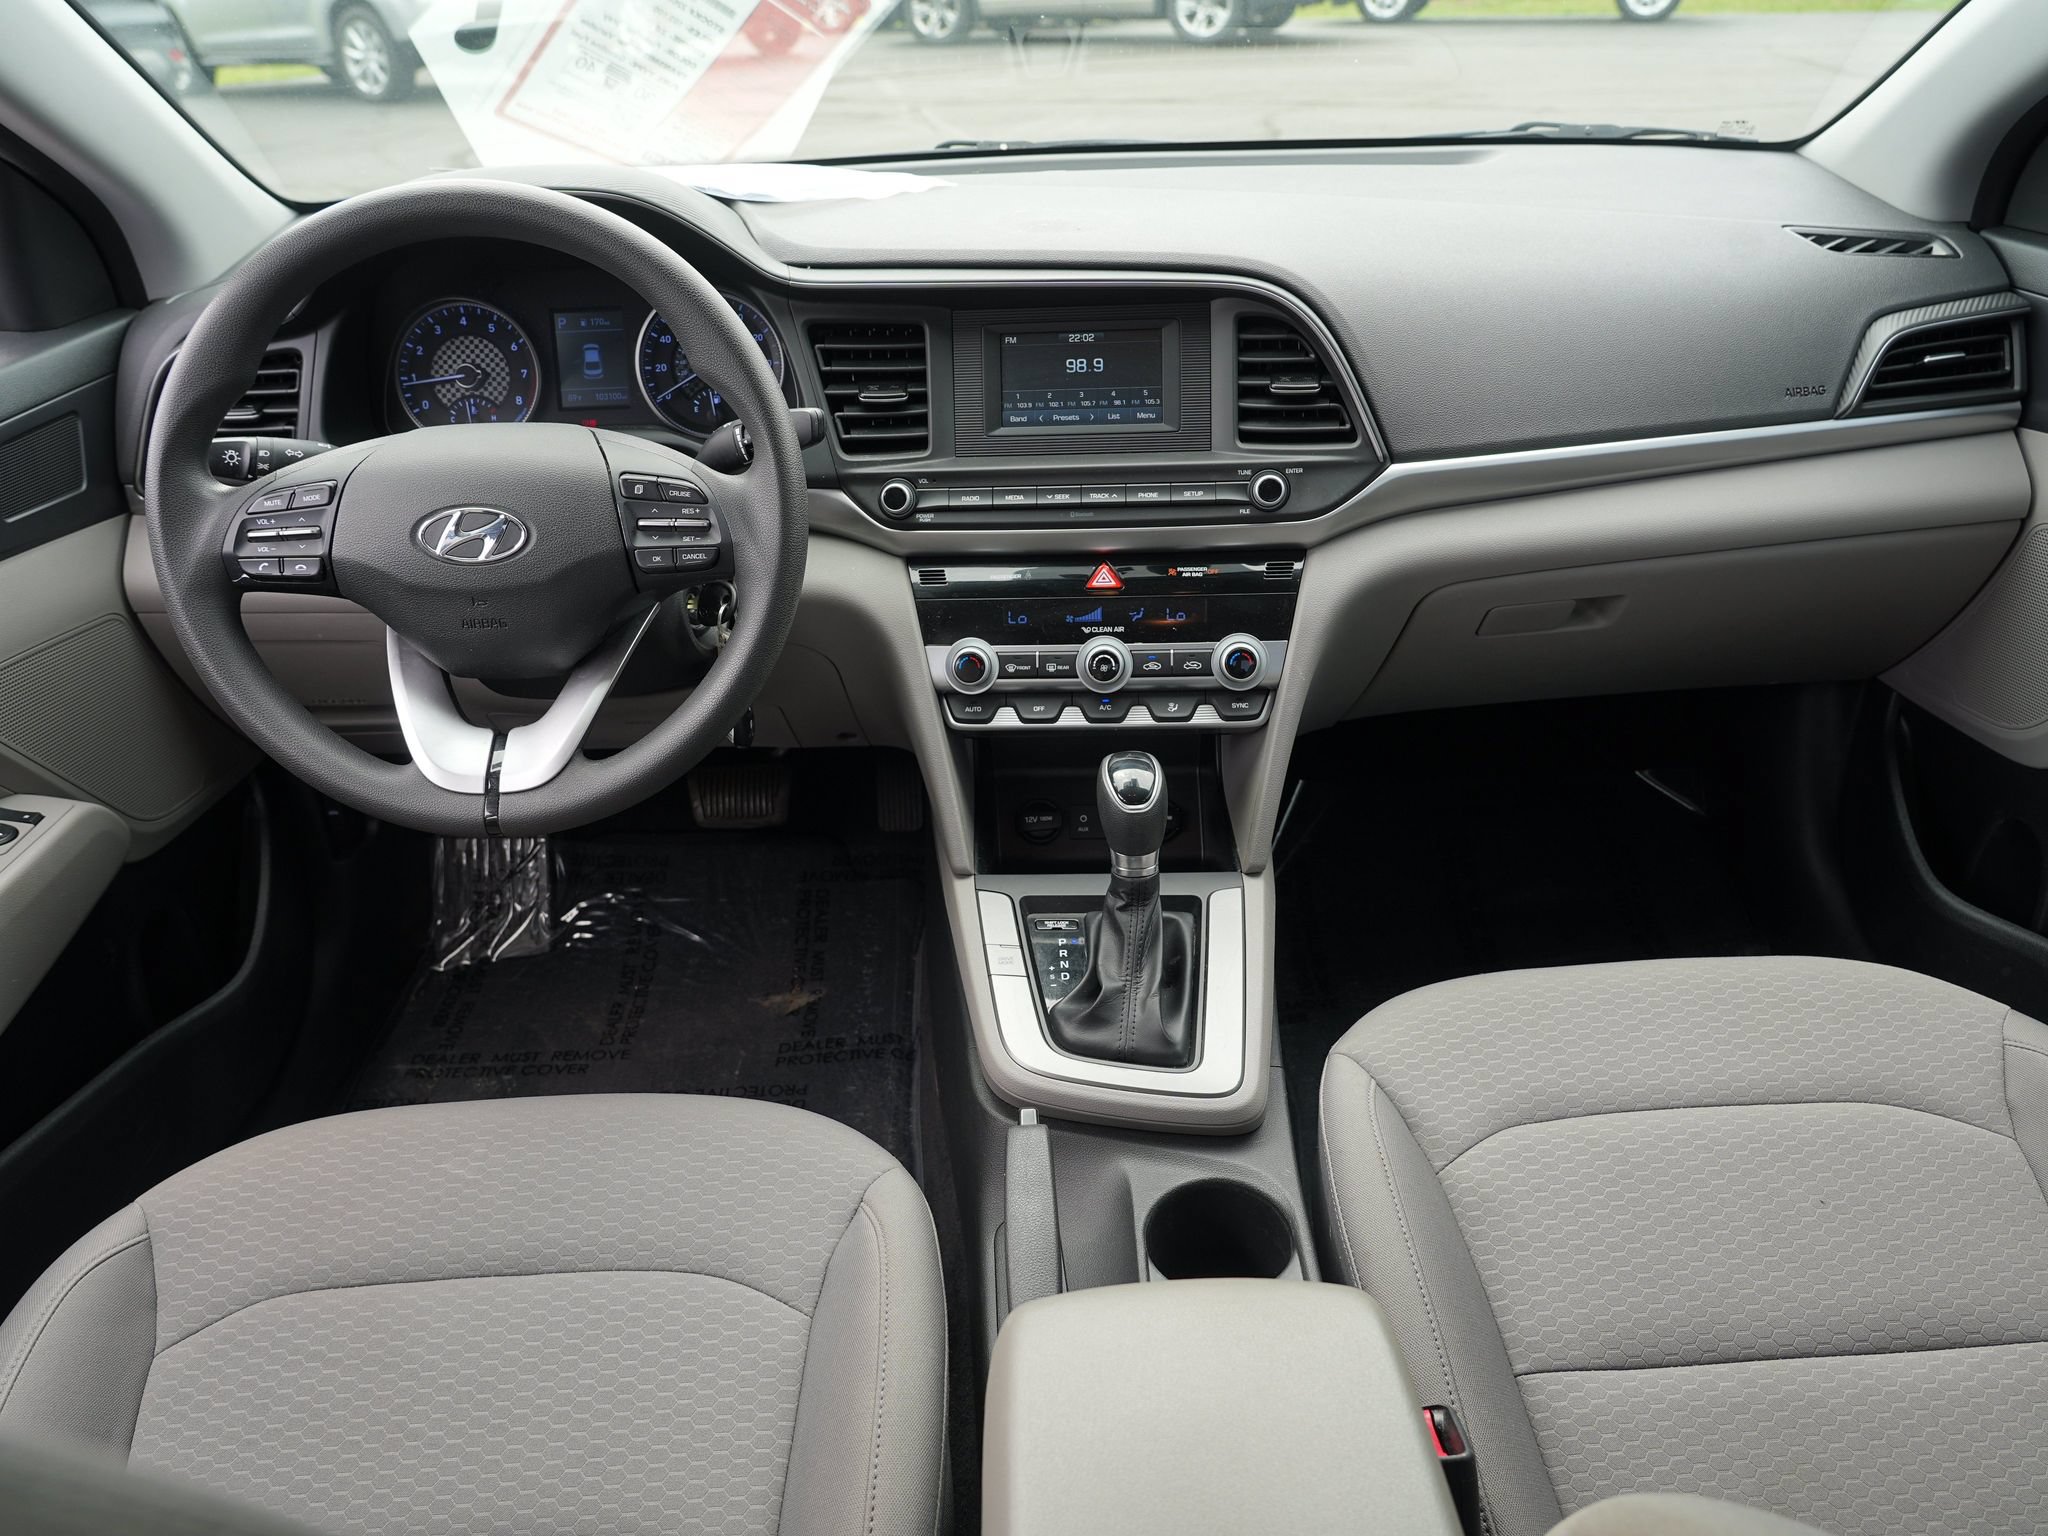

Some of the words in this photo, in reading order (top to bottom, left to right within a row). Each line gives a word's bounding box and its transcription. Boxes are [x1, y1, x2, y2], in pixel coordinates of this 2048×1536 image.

[460, 317, 467, 326] 4
[558, 317, 567, 329] P
[435, 325, 442, 335] 3
[488, 324, 496, 333] 5
[659, 335, 672, 344] 40
[1068, 333, 1095, 343] 22:02
[416, 346, 424, 355] 2
[511, 343, 518, 351] 6
[655, 363, 667, 372] 20
[1065, 358, 1104, 373] 98.9
[521, 369, 528, 378] 7
[1785, 385, 1826, 398] AIRBAG
[516, 396, 523, 405] 8
[422, 401, 430, 410] 0
[1010, 415, 1028, 423] Band
[1107, 412, 1120, 420] List
[1136, 411, 1156, 419] Menu
[303, 494, 321, 502] MODE
[668, 490, 692, 498] CRUISE
[263, 499, 282, 507] MUTE
[461, 618, 508, 630] AIRBAG
[1024, 816, 1038, 824] 12V
[1058, 938, 1067, 947] P
[1059, 949, 1068, 957] R
[1060, 960, 1069, 969] N
[1060, 972, 1070, 980] D
[777, 1036, 849, 1055] DEALER
[411, 1051, 482, 1066] DEALER
[492, 1050, 542, 1064] MUST
[551, 1048, 633, 1062] REMOVE
[775, 1048, 886, 1068] PROTECTIVE
[404, 1064, 517, 1079] PROTECTIVE
[521, 1063, 590, 1076] COVER
